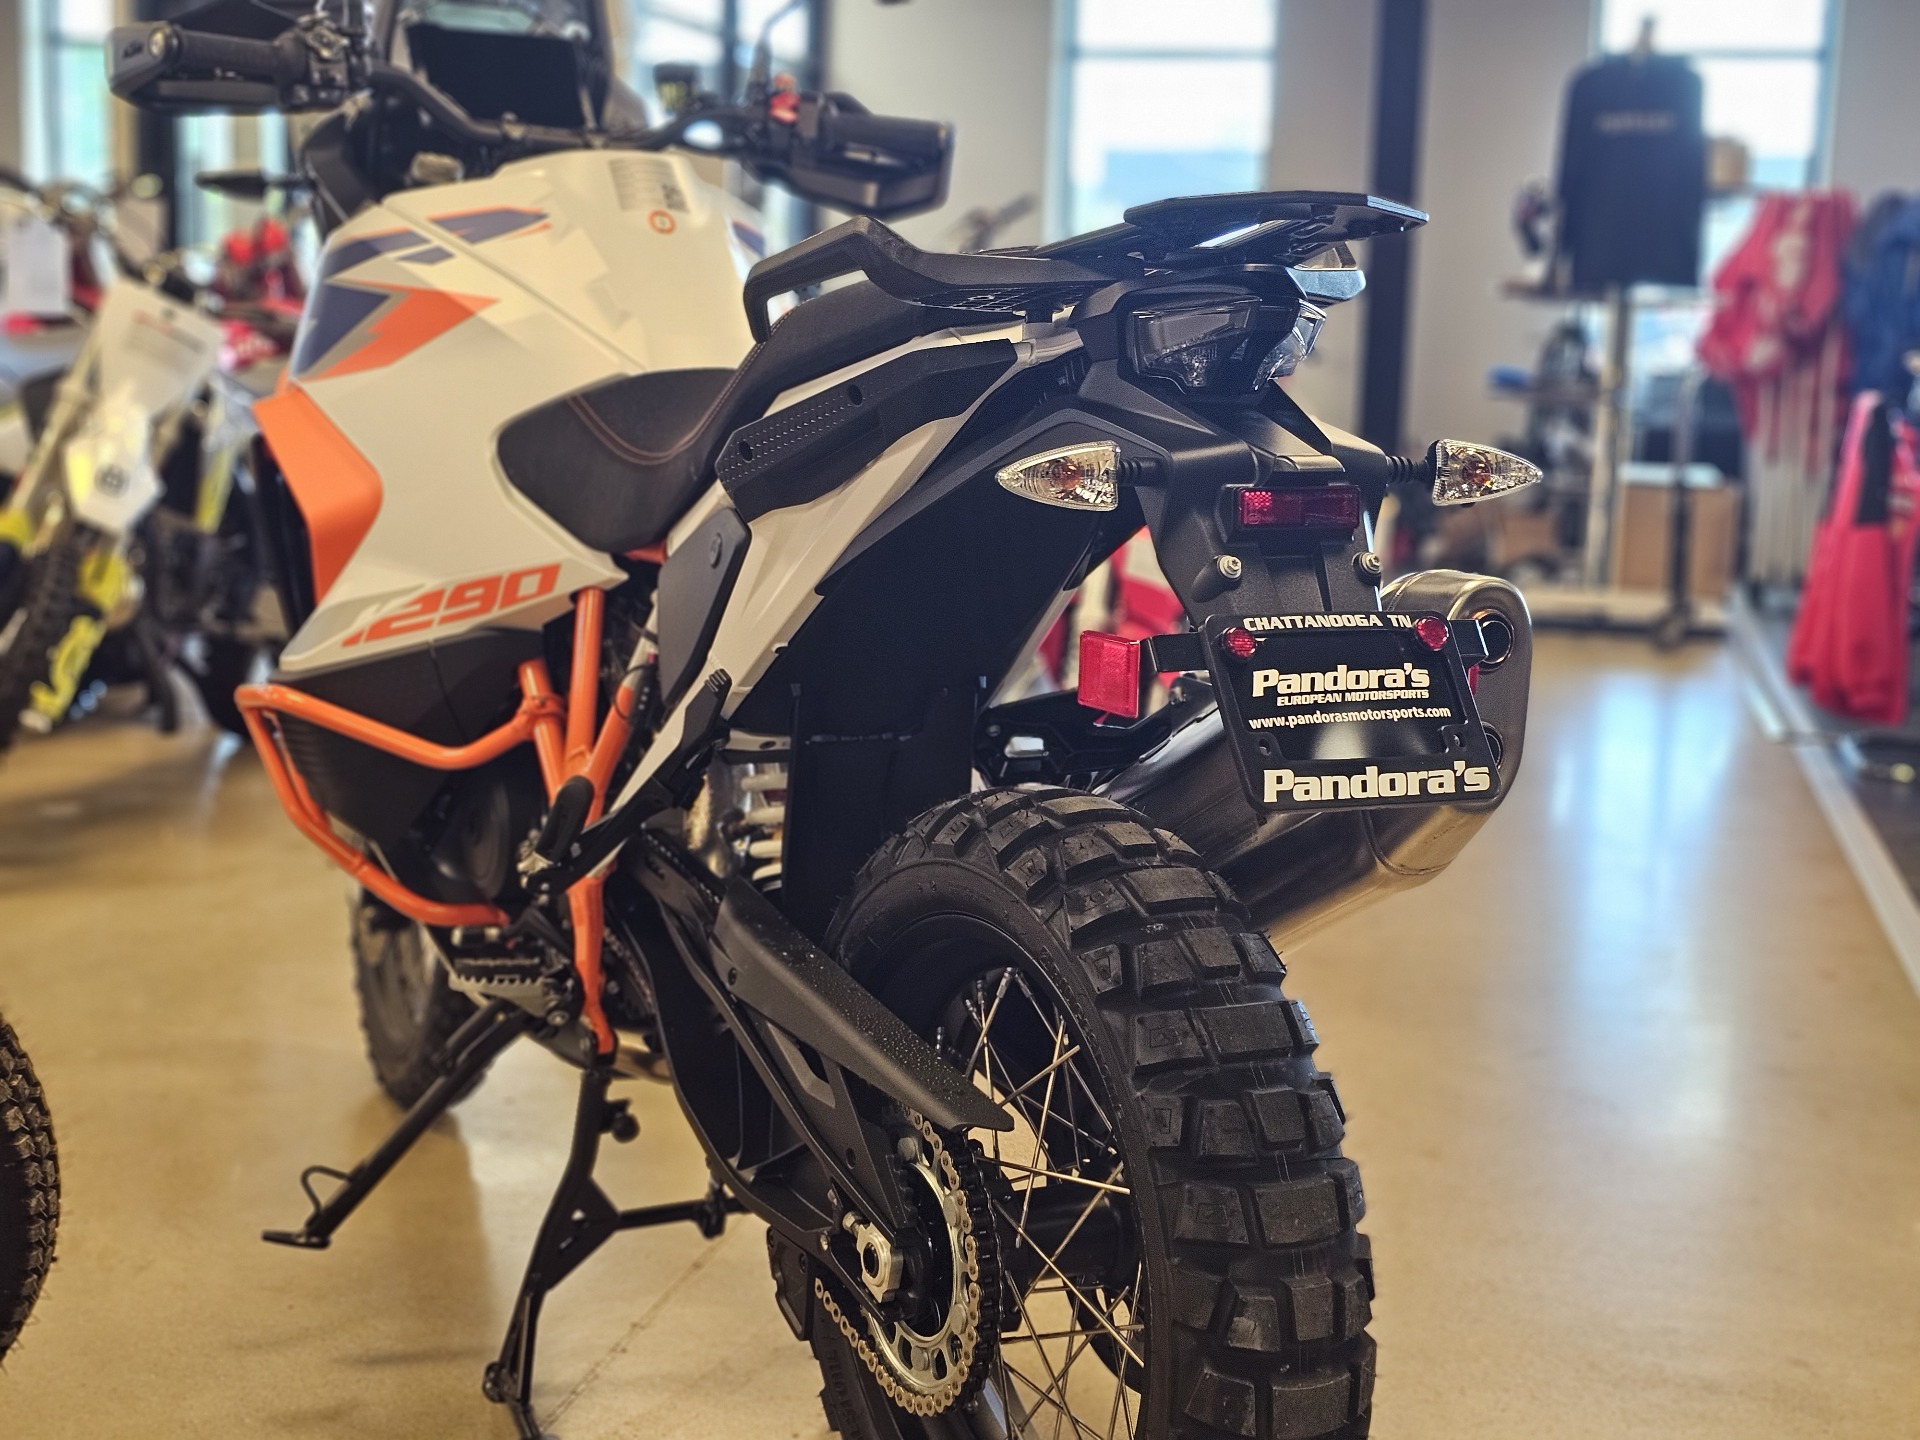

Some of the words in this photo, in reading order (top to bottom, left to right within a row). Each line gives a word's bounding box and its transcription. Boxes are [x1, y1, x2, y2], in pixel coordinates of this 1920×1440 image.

[1243, 614, 1383, 632] CHATTANOOGA
[1386, 614, 1413, 629] TN
[1252, 662, 1430, 698] Pandora's
[1276, 692, 1342, 707] EUROPEAN
[1344, 689, 1430, 703] MOTORSPORTS
[1248, 706, 1452, 730] www.pandorasmotorsports.com
[1263, 760, 1491, 804] Pandora's
